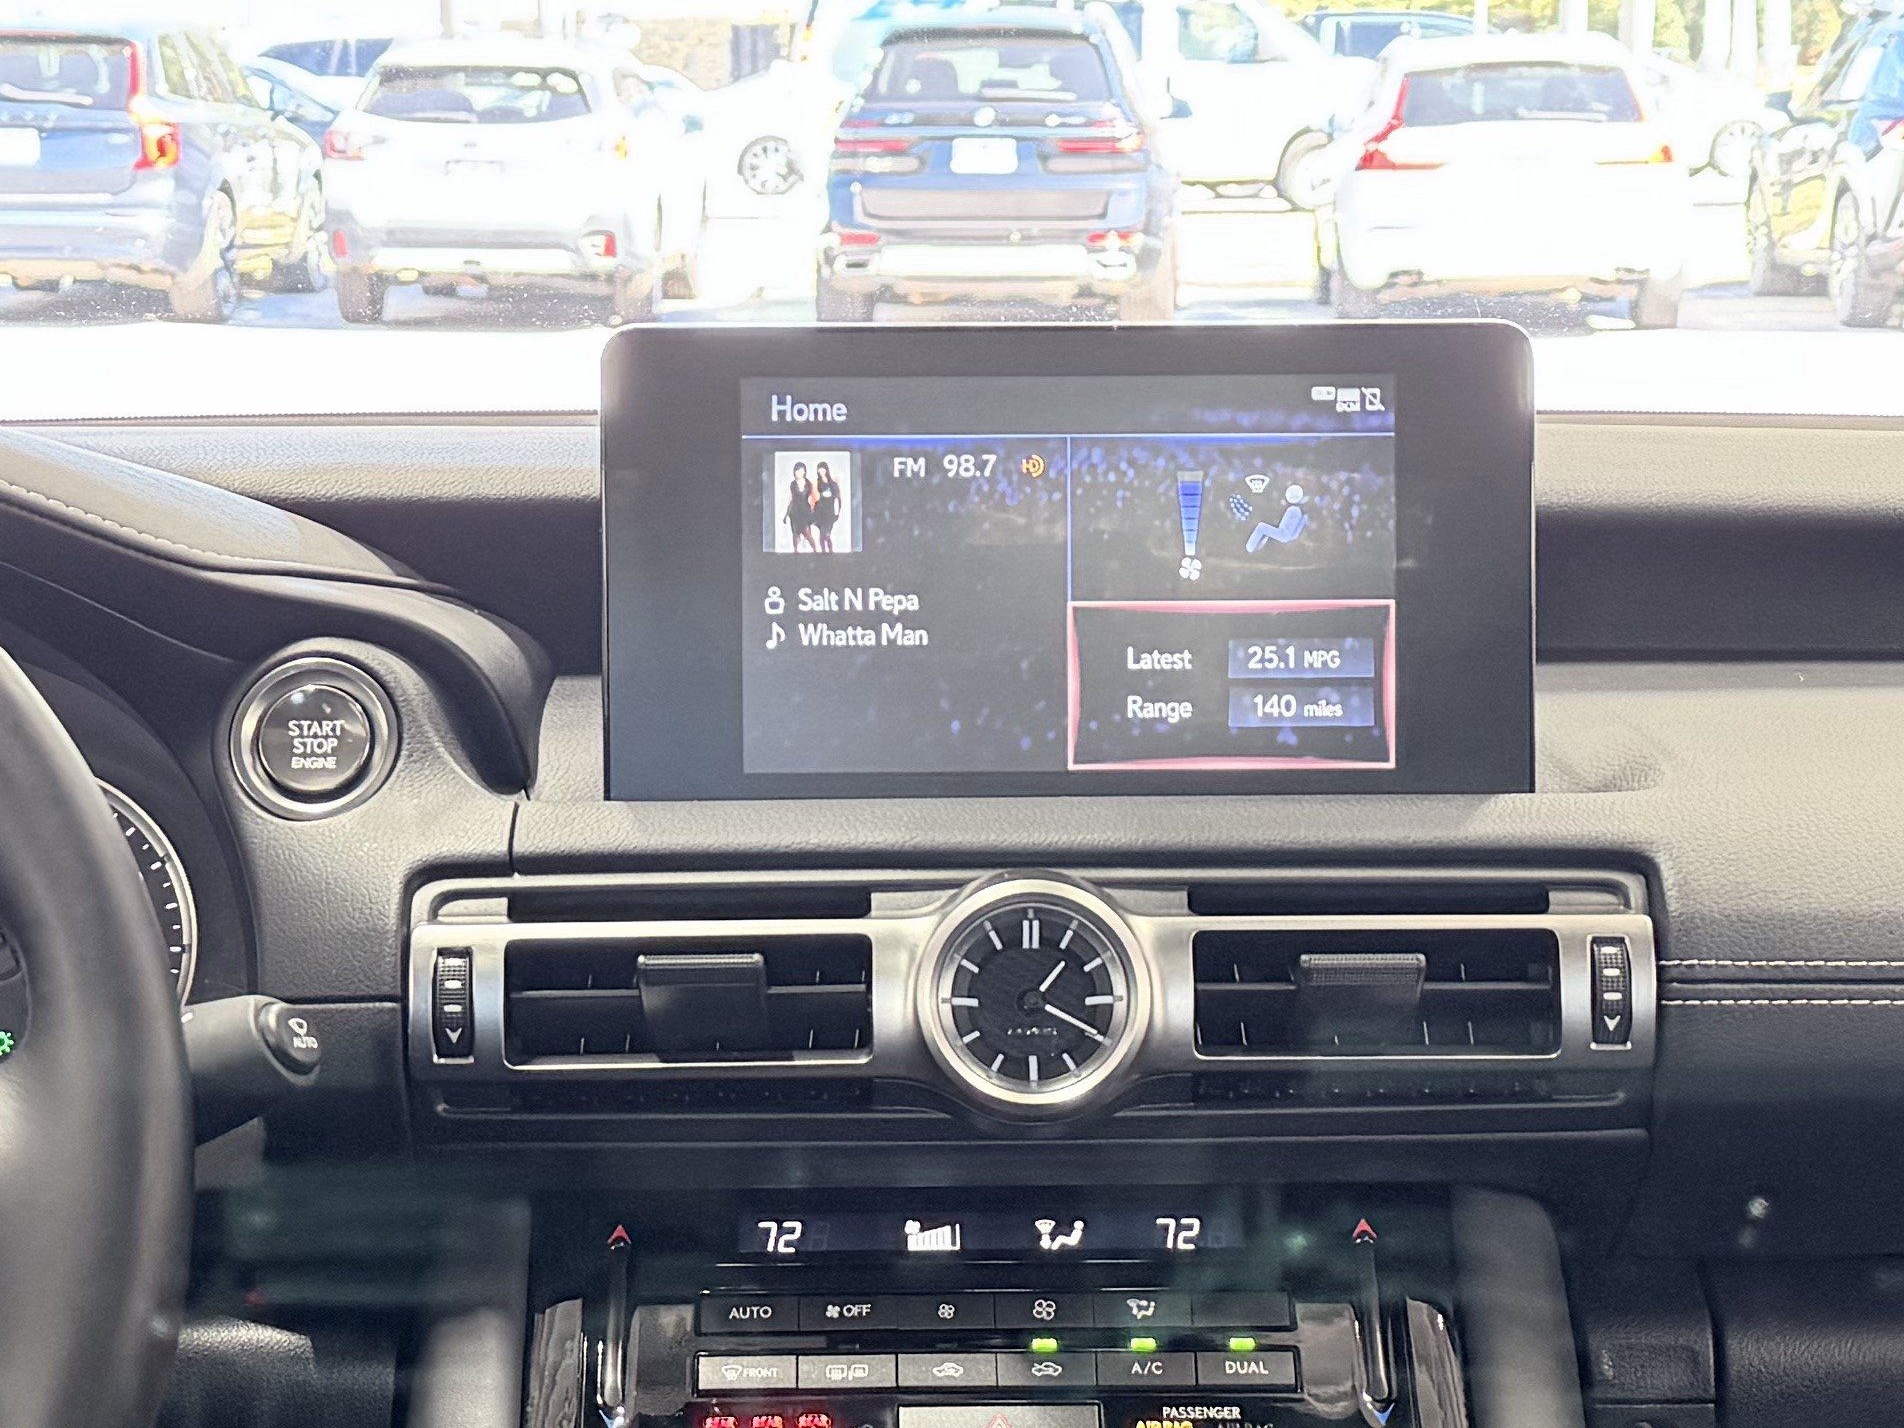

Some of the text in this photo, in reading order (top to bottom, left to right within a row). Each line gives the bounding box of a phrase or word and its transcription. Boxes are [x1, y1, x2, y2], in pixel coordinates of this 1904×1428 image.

[771, 395, 847, 422] Home
[893, 457, 926, 478] FM
[943, 454, 998, 477] 98.7
[798, 588, 919, 615] Salt N Pepa
[798, 623, 929, 647] Whatta Man
[1127, 645, 1341, 669] Latest 25.1 MPG
[1127, 694, 1343, 724] Range 140 miles
[288, 719, 345, 737] START
[292, 738, 338, 754] STOP
[291, 756, 337, 769] ENGINE
[757, 1221, 802, 1253] 72
[1155, 1218, 1200, 1250] 72
[728, 1305, 772, 1320] AUTO
[843, 1303, 871, 1318] OFF
[743, 1367, 778, 1379] FRONT
[1131, 1362, 1163, 1376] A/C
[1225, 1360, 1269, 1376] DUAL
[1162, 1406, 1242, 1419] PASSENGER
